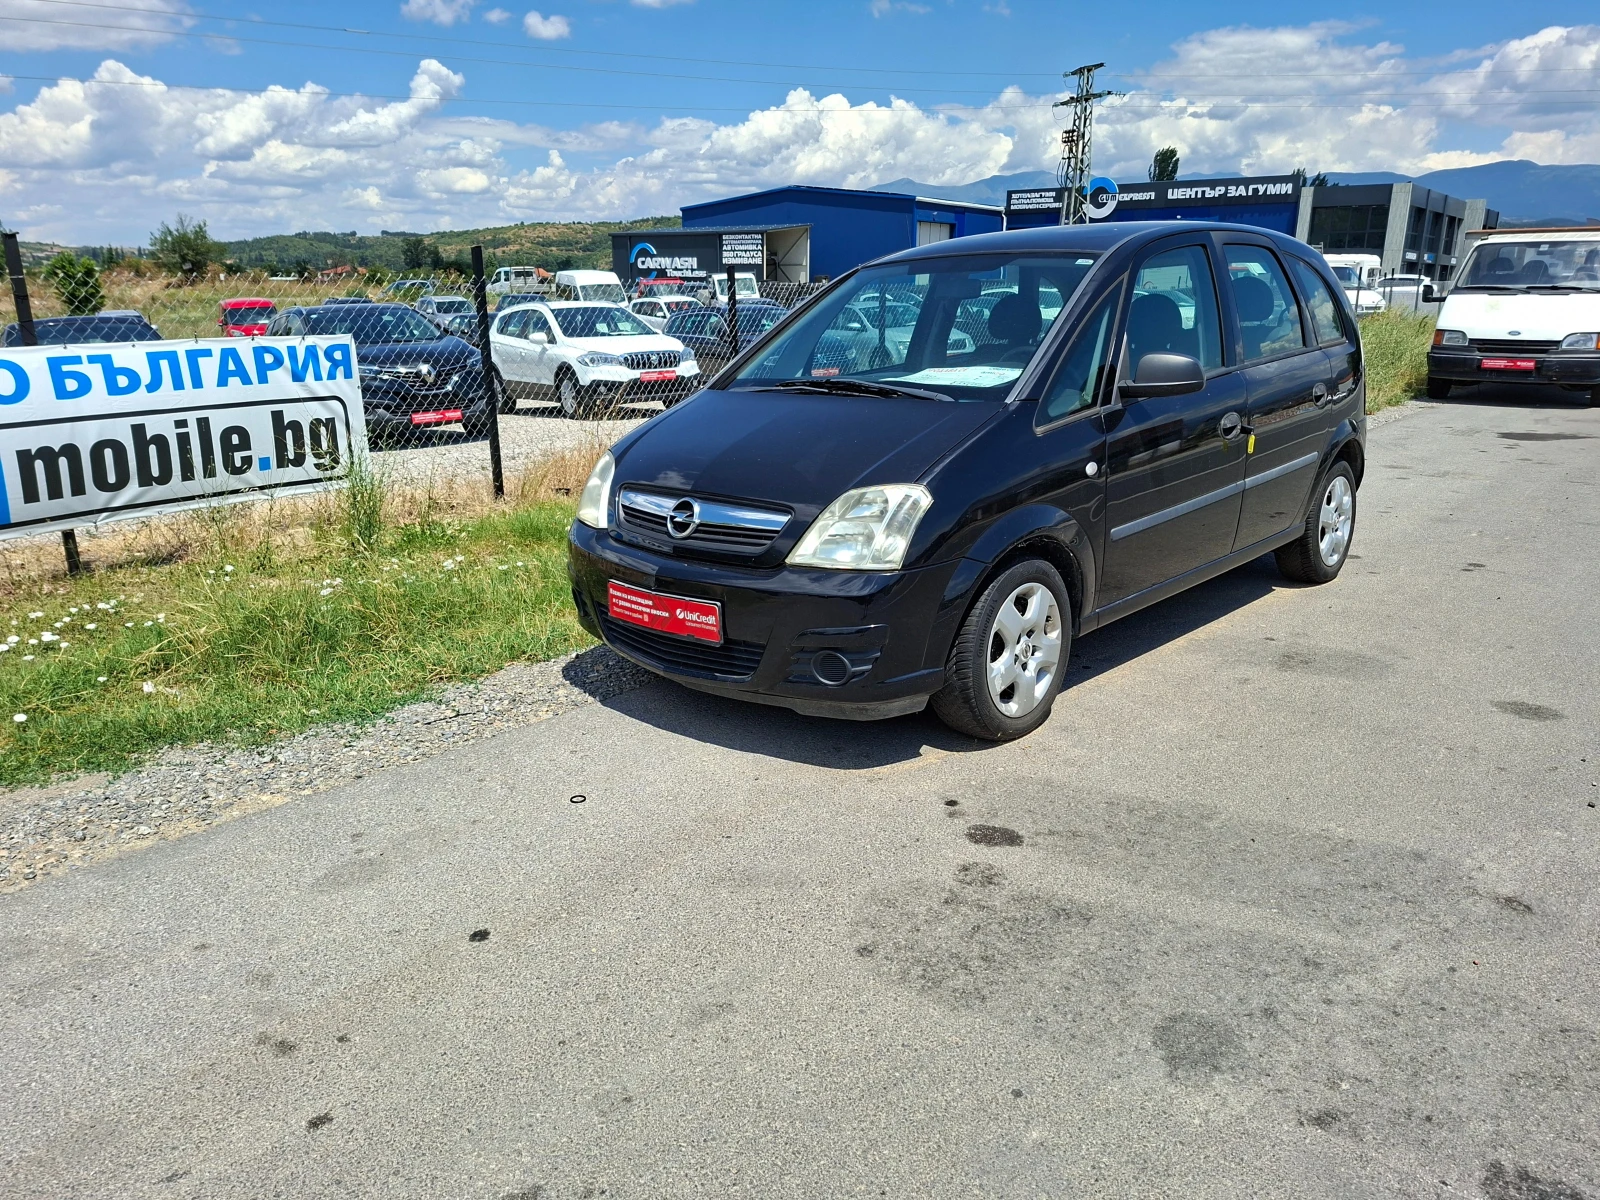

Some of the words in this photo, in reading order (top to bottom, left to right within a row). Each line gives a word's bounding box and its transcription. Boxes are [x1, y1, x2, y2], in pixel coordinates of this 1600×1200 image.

[1099, 193, 1118, 202] GUM
[1167, 187, 1225, 200] ЦЕНТЪР
[1226, 185, 1247, 197] ЗА
[1247, 183, 1293, 196] ГУМИ
[734, 250, 763, 258] ГРАДУСА
[637, 257, 698, 269] CARWASH
[722, 257, 763, 265] ИЗМИВАНЕ
[47, 343, 353, 401] БЪЛГАРИЯ
[16, 410, 341, 505] mobile.bg
[684, 610, 716, 625] UniCredit
